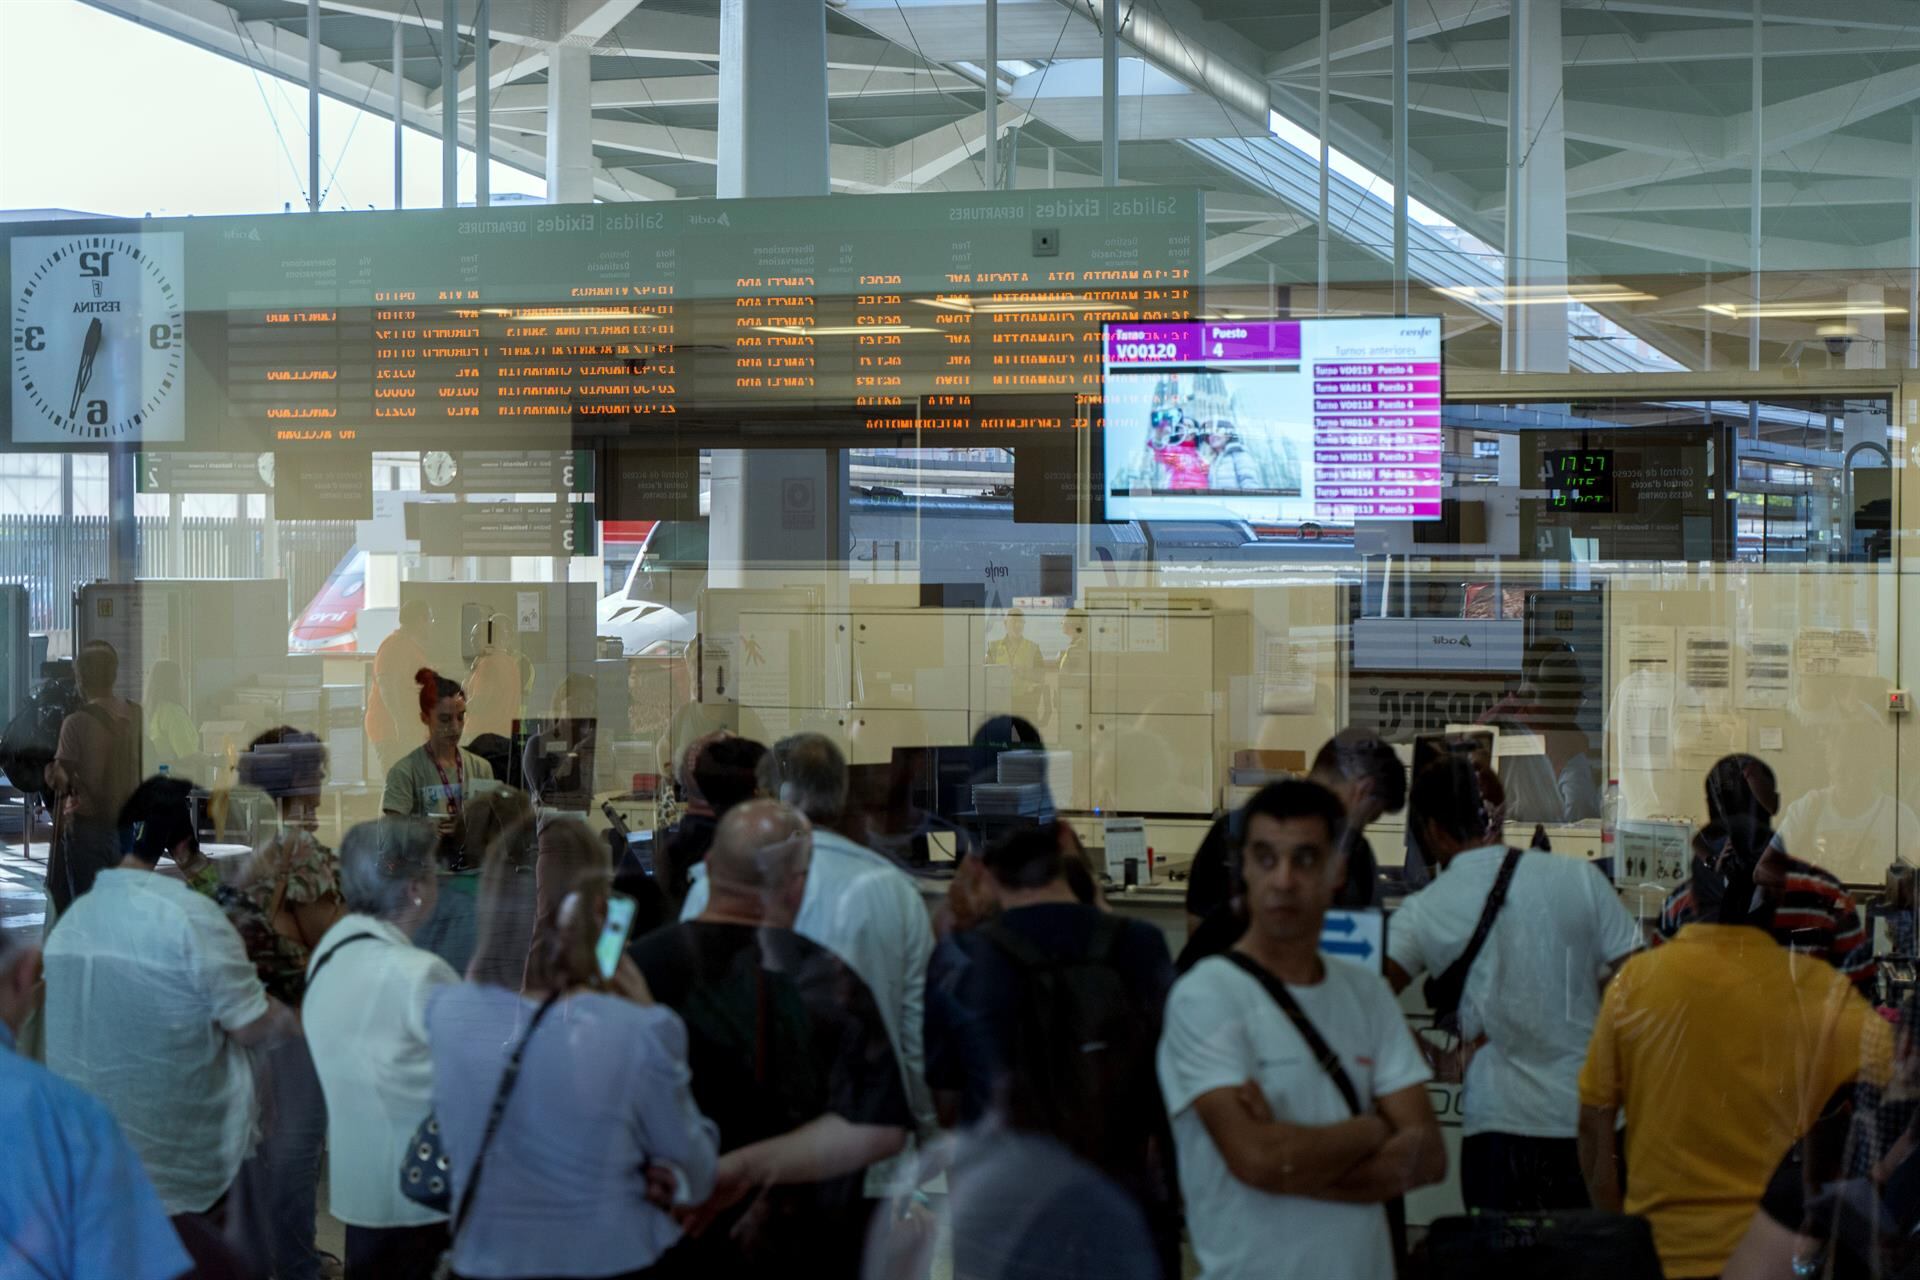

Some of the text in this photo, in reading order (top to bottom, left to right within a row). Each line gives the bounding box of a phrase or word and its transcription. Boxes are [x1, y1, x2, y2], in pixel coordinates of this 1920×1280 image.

[1212, 327, 1248, 340] Puesto
[1400, 327, 1433, 341] renfe
[1212, 342, 1224, 358] 4
[1335, 345, 1417, 356] Turnos anteriores
[1316, 366, 1339, 375] Turno
[1378, 366, 1406, 375] Puesto
[1316, 383, 1339, 392] Turno
[1378, 383, 1406, 392] Puesto
[1316, 400, 1339, 410] Turno
[1378, 400, 1406, 410] Puesto
[1316, 418, 1339, 427] Turno
[1378, 418, 1406, 427] Puesto
[1316, 453, 1339, 462] Turno
[1378, 453, 1406, 462] Puesto
[1316, 488, 1339, 497] Turno
[1378, 488, 1406, 497] Puesto
[1378, 505, 1406, 514] Puesto
